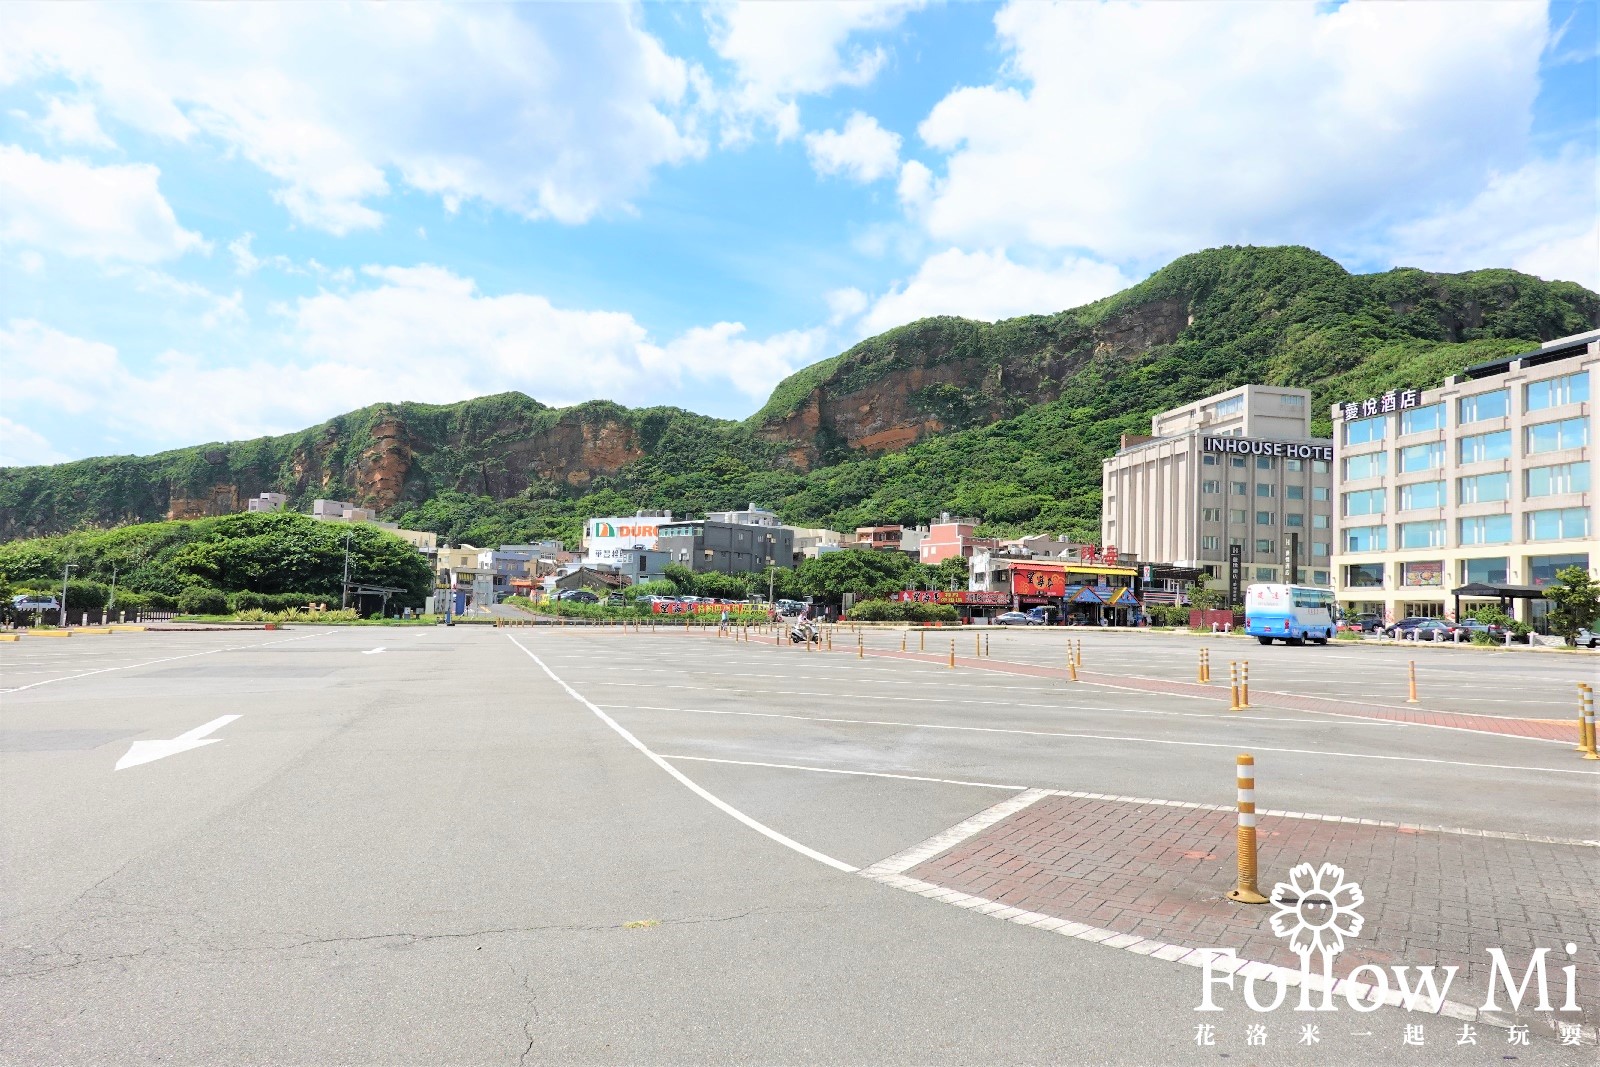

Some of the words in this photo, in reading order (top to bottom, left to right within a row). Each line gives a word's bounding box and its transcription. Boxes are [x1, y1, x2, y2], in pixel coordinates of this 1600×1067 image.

[1344, 388, 1417, 421] 薆悅酒店
[1207, 437, 1282, 456] INHOUSE
[1287, 444, 1332, 460] HOTE
